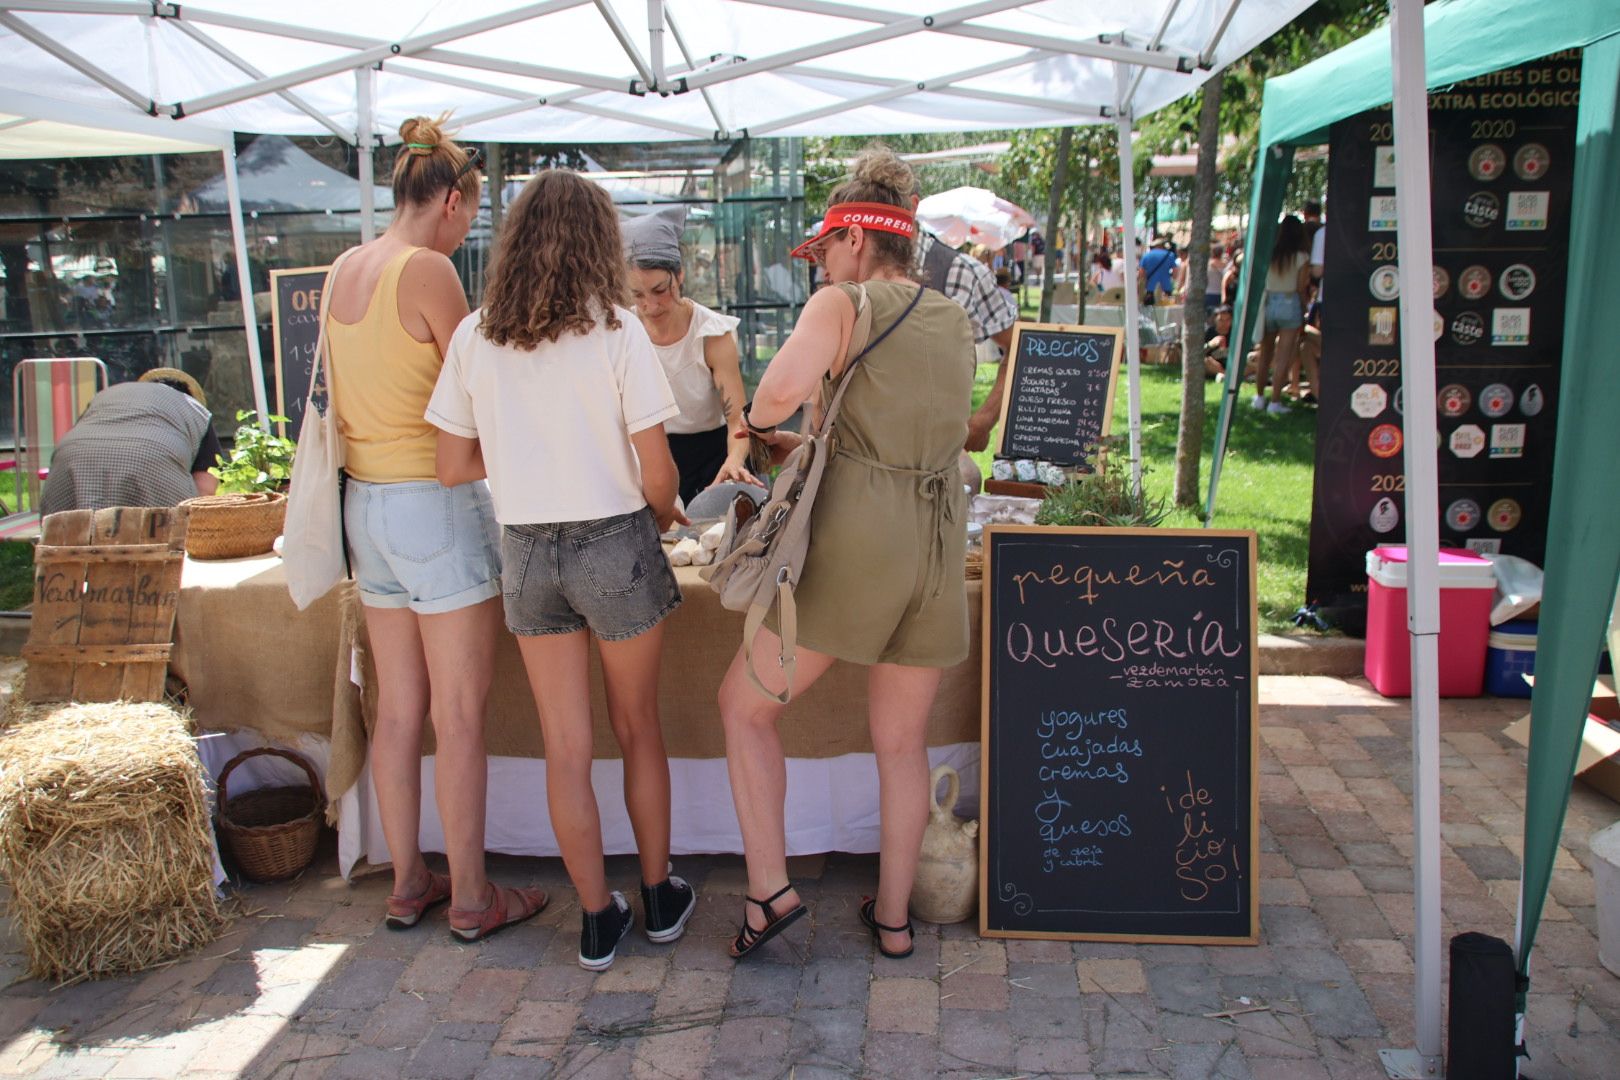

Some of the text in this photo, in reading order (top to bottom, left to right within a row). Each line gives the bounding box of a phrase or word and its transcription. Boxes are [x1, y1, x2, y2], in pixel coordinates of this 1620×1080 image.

[1527, 69, 1552, 85] DE
[1557, 67, 1580, 83] OL
[1369, 123, 1394, 141] 20
[1471, 120, 1515, 139] 2020
[1464, 202, 1499, 220] taste
[843, 214, 912, 233] COMPRESS
[1372, 242, 1399, 260] 20
[291, 289, 322, 311] OF
[1452, 321, 1484, 338] taste
[1023, 366, 1053, 376] CREMAS
[1353, 359, 1400, 376] 2022
[1018, 395, 1044, 404] QUESO
[1047, 397, 1077, 406] FRESCO
[1371, 475, 1405, 491] 202
[1013, 560, 1216, 605] pequeña
[1037, 708, 1128, 740] yogures
[1035, 787, 1072, 823] y
[1039, 814, 1132, 844] quesos
